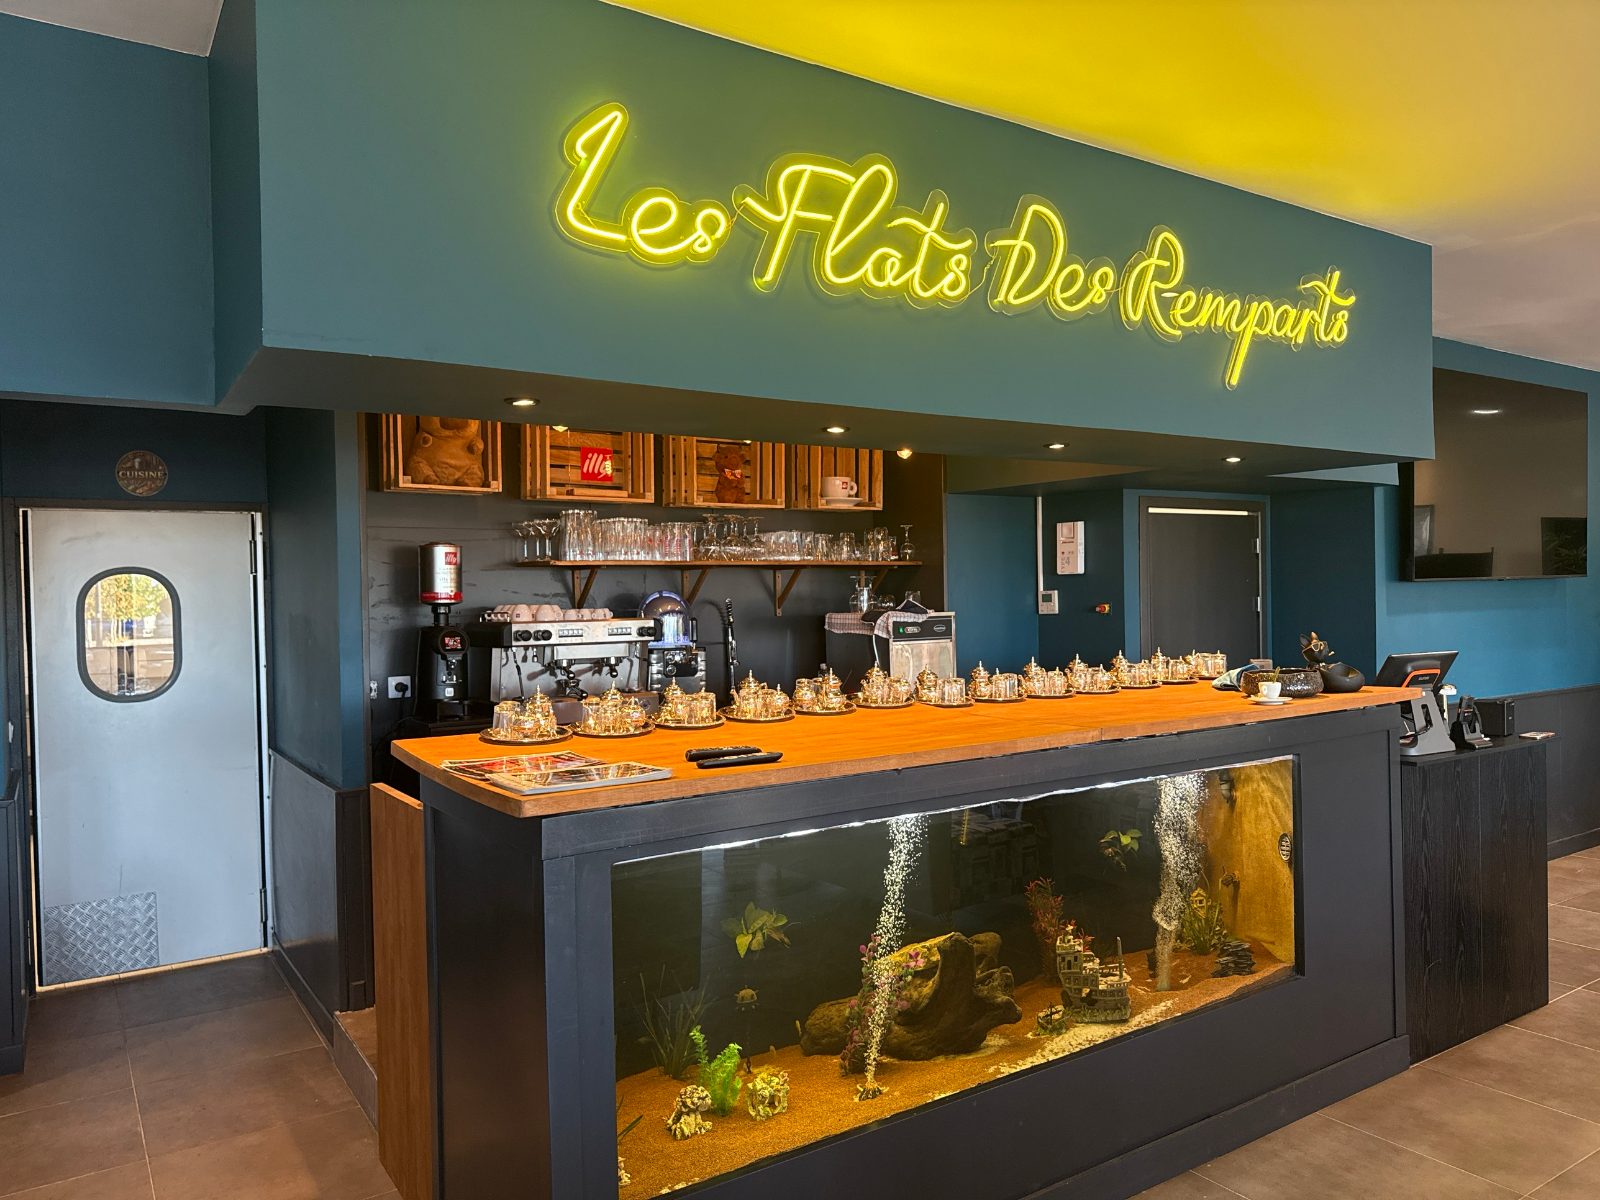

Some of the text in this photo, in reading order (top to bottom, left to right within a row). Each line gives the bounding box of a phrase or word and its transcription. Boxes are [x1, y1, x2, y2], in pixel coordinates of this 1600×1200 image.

[568, 110, 727, 254] Les
[989, 203, 1114, 311] Des
[1121, 230, 1357, 387] Remparts
[119, 470, 165, 479] CUISINE
